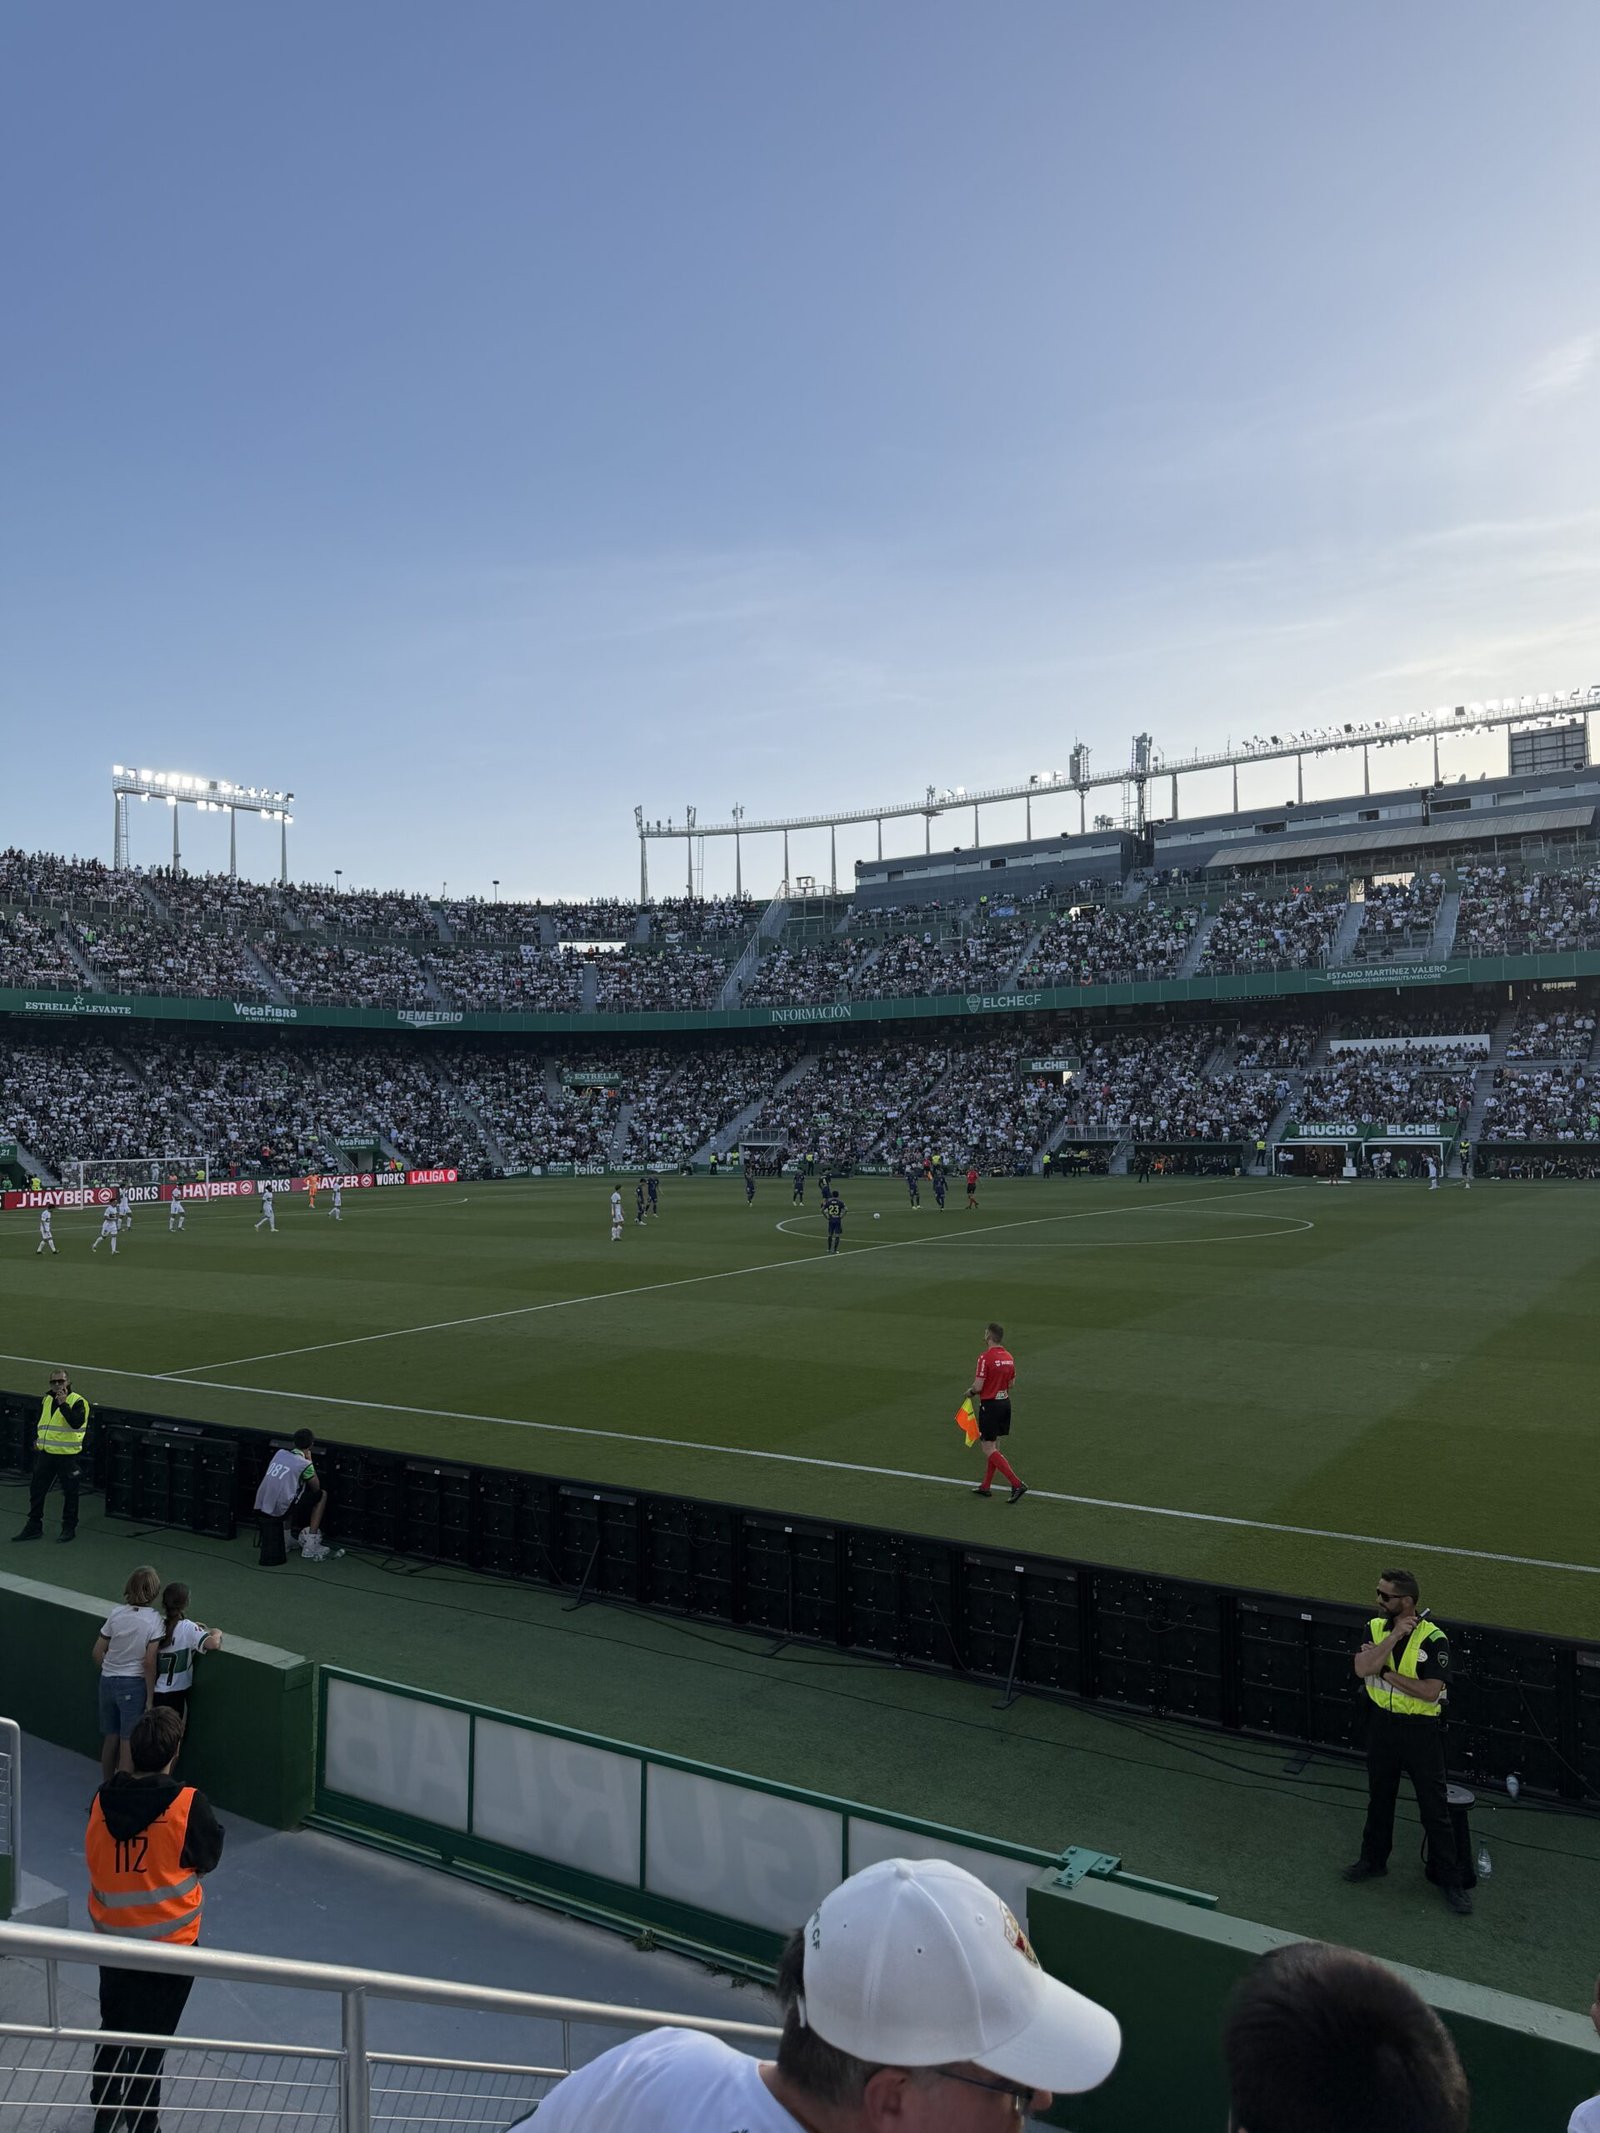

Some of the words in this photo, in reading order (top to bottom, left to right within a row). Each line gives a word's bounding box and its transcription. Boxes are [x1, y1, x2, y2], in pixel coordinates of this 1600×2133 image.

[1326, 970, 1363, 980] ESTADIO
[1365, 967, 1410, 977] MARTÍNEZ
[1411, 965, 1448, 974] VALERO
[25, 1002, 78, 1012] ESTRELLA
[86, 1005, 132, 1014] LEVANTE
[771, 1003, 852, 1022] INFORMACIÓN
[397, 1010, 463, 1022] DEMETRIO
[574, 1072, 620, 1080] ESTRELLA
[17, 1189, 95, 1208] J'HAYBER
[376, 1172, 406, 1186] WORKS
[412, 1170, 445, 1183] LALIGA
[829, 1204, 840, 1215] 23
